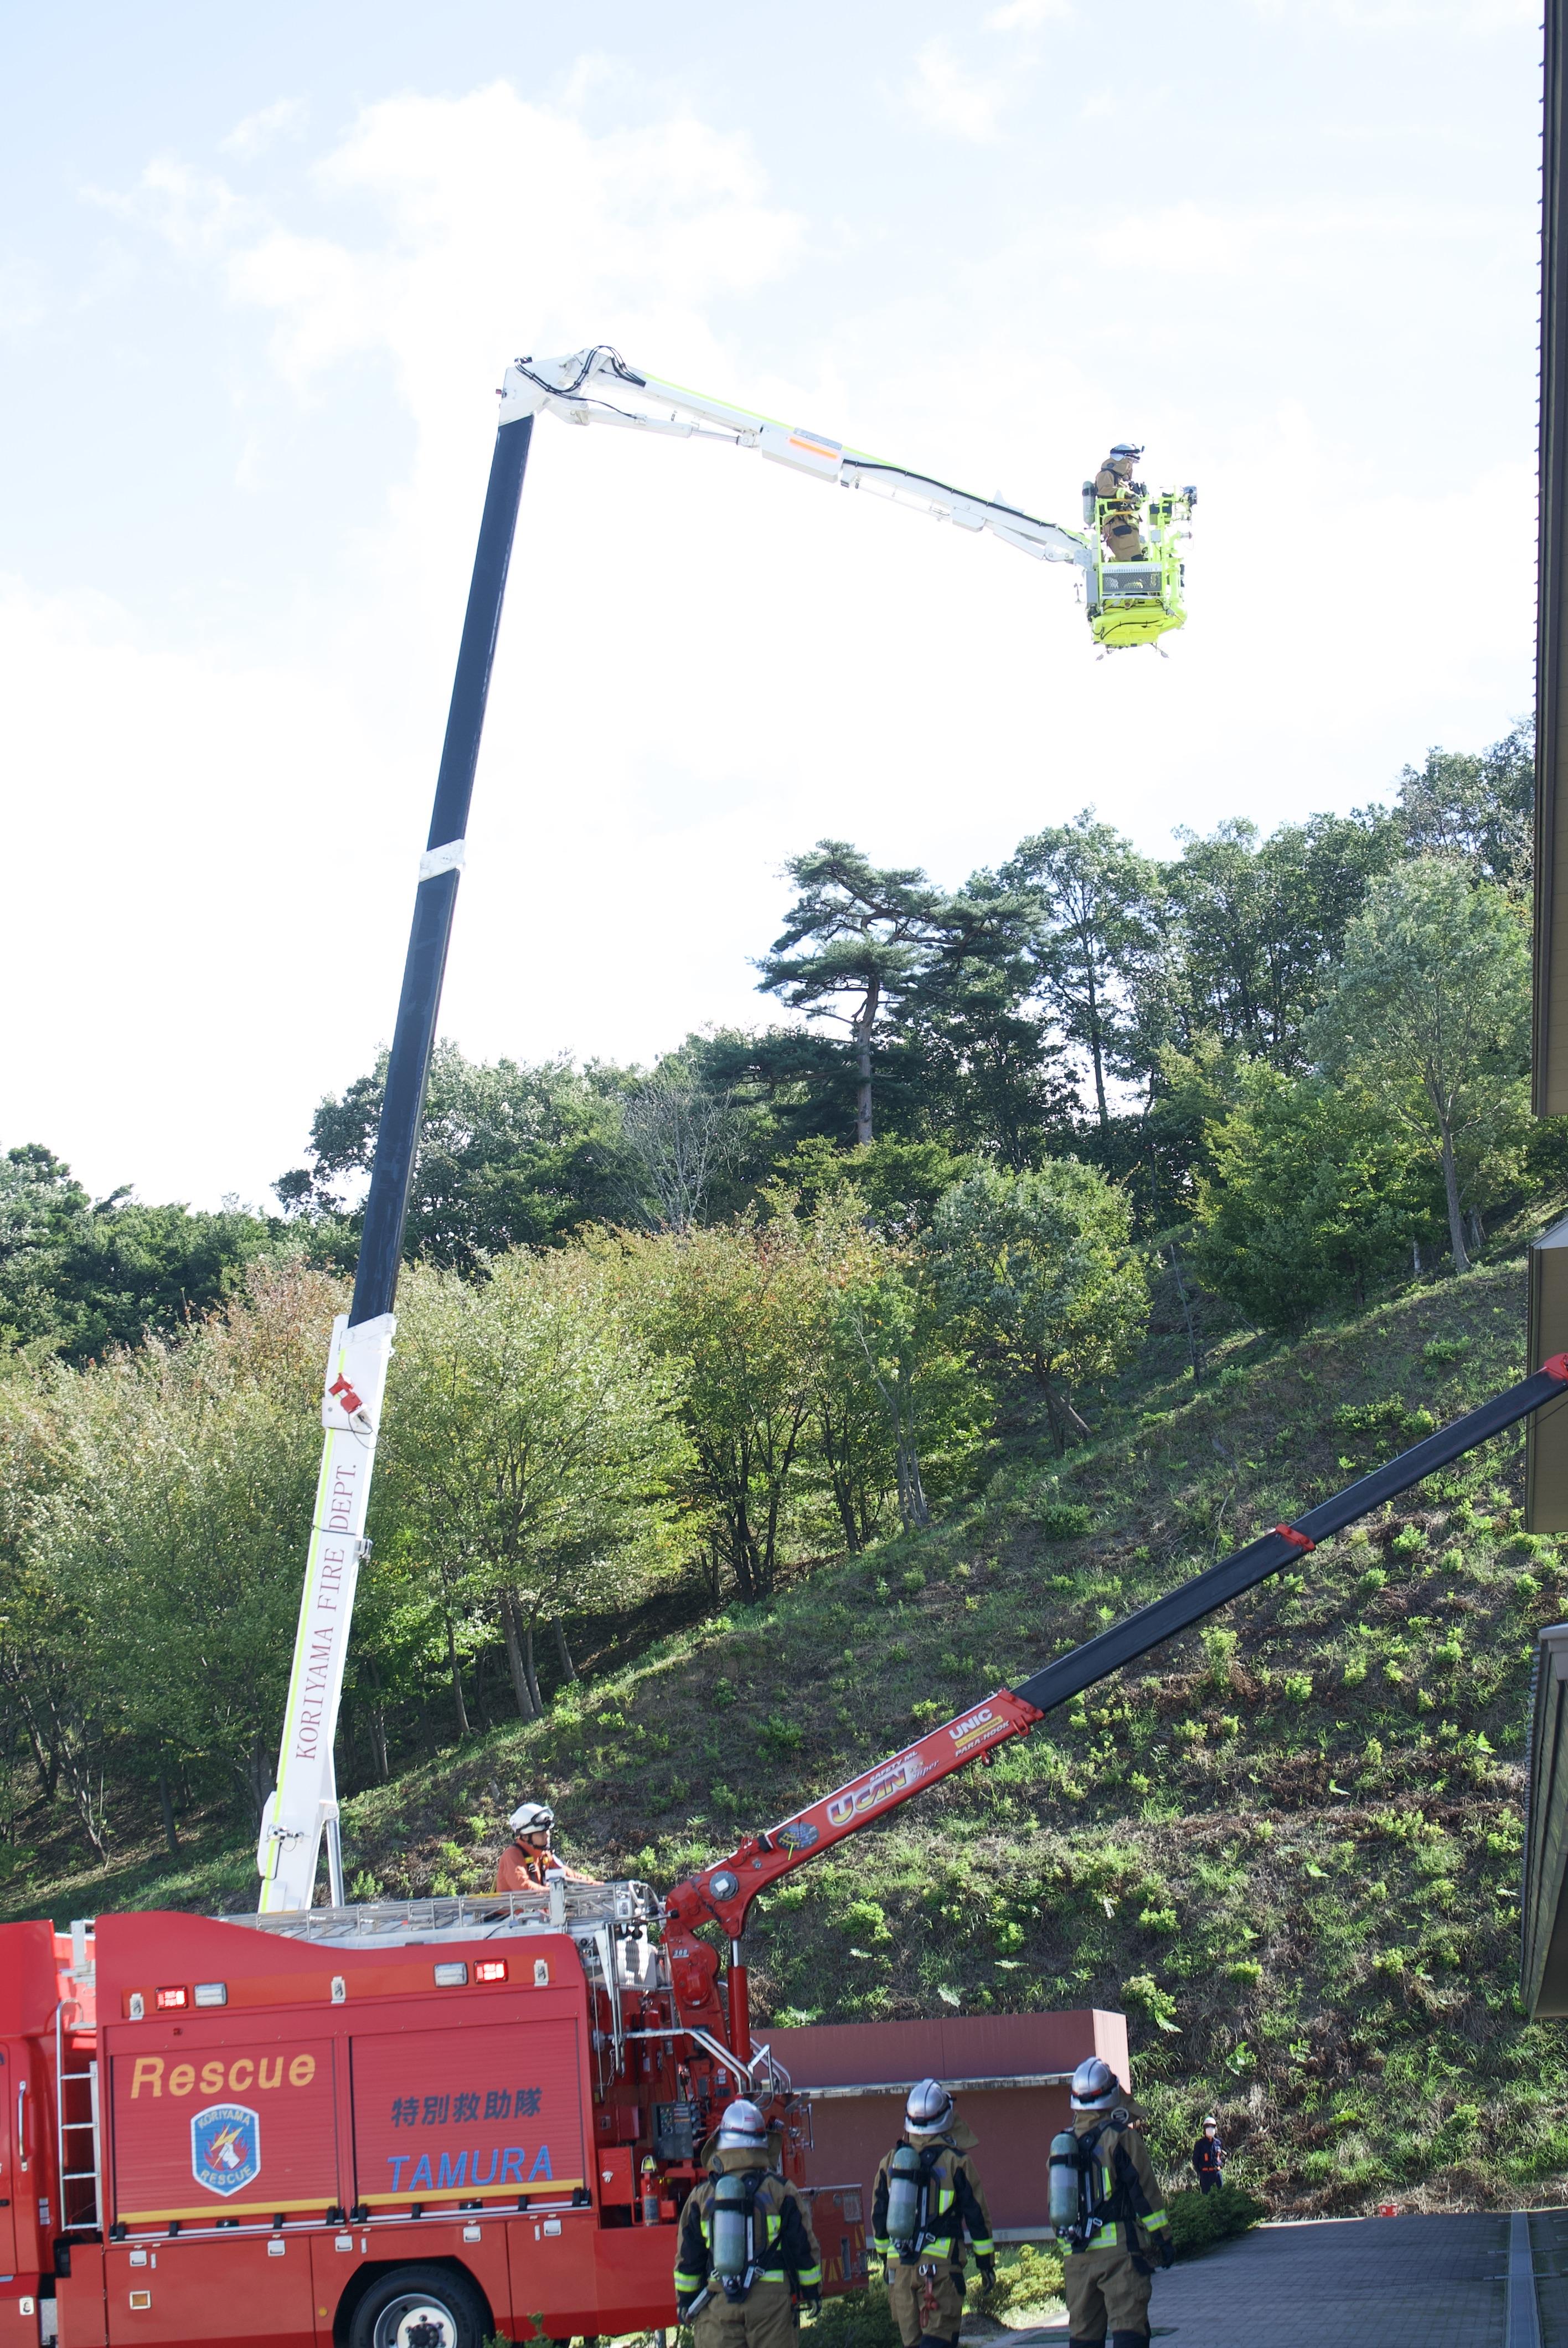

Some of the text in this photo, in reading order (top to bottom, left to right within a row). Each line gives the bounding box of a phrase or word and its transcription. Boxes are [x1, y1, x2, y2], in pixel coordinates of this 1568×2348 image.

[296, 1465, 357, 1761] KORIYAMA FIRE DEPT.
[948, 1708, 992, 1739] UNIC
[869, 1750, 918, 1783] SAFETY ML
[130, 2054, 316, 2099] Rescue
[198, 2109, 251, 2129] KORIYAMA
[391, 2087, 542, 2128] 特別救助隊
[200, 2165, 254, 2186] RESCUE
[386, 2145, 553, 2192] TAMURA
